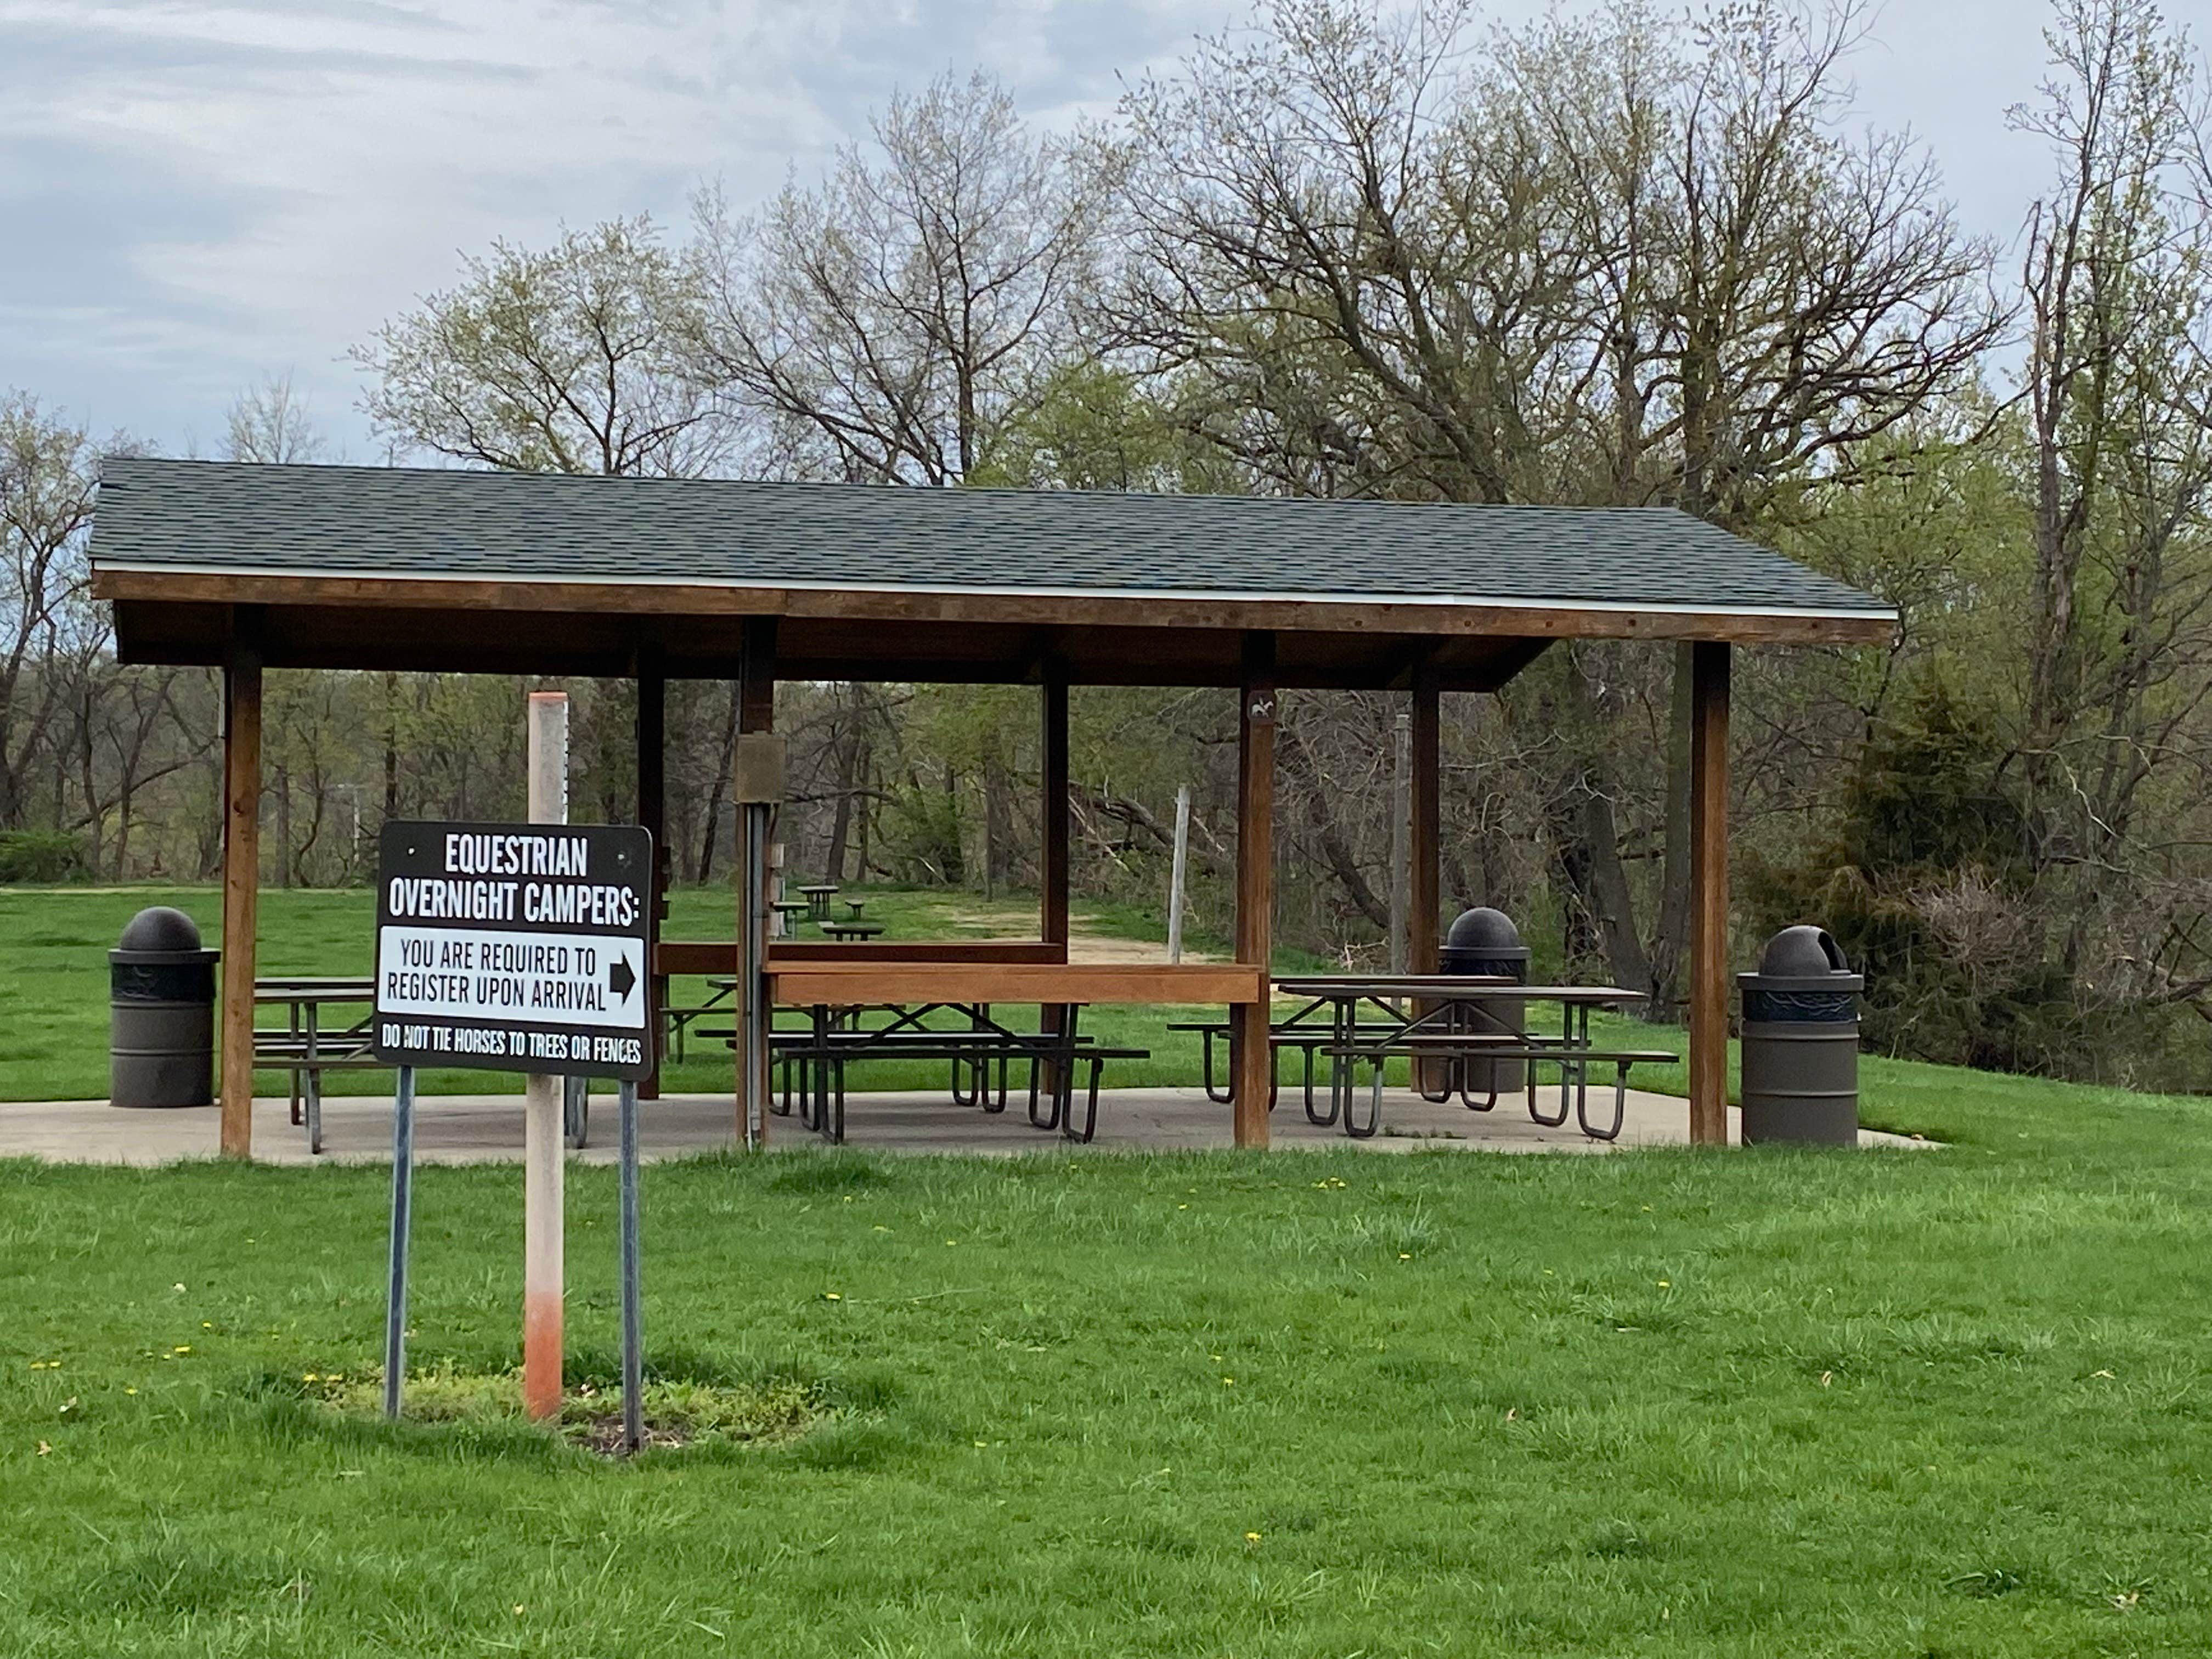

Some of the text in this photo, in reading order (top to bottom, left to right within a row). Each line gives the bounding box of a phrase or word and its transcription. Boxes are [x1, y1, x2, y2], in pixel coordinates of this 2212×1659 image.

[445, 833, 588, 877] EQUESTRIAN
[390, 878, 640, 927] OVERNIGHT CAMPERS:
[401, 939, 596, 976] YOU ARE REQUIRED TO
[387, 972, 606, 1011] REGISTER UPON ARRIVAL
[382, 1024, 641, 1064] DO NOT TIE HORSES TO TREES OR FENCES
